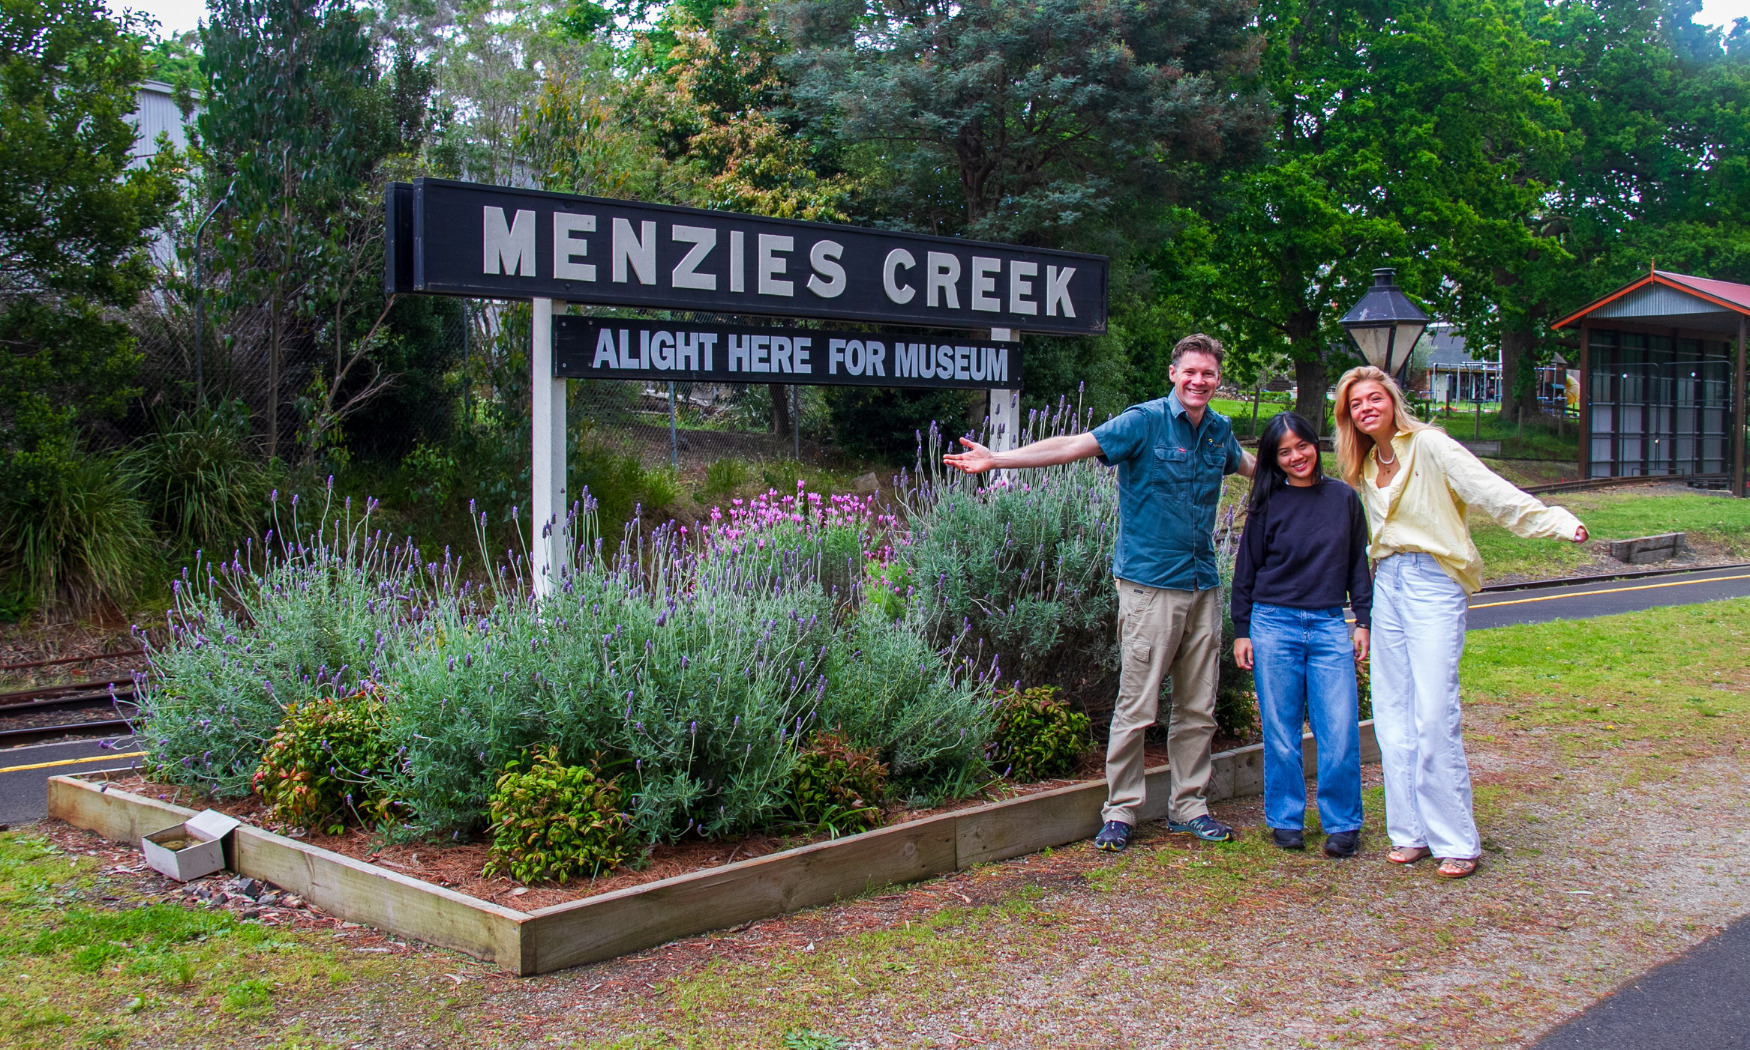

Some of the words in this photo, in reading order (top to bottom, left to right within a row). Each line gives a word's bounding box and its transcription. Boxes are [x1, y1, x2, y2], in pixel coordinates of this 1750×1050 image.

[483, 205, 847, 299] MENZIES
[883, 248, 1077, 318] CREEK
[592, 328, 718, 371] ALIGHT
[728, 334, 812, 374] HERE
[829, 338, 886, 377] FOR
[895, 342, 1008, 382] MUSEUM
